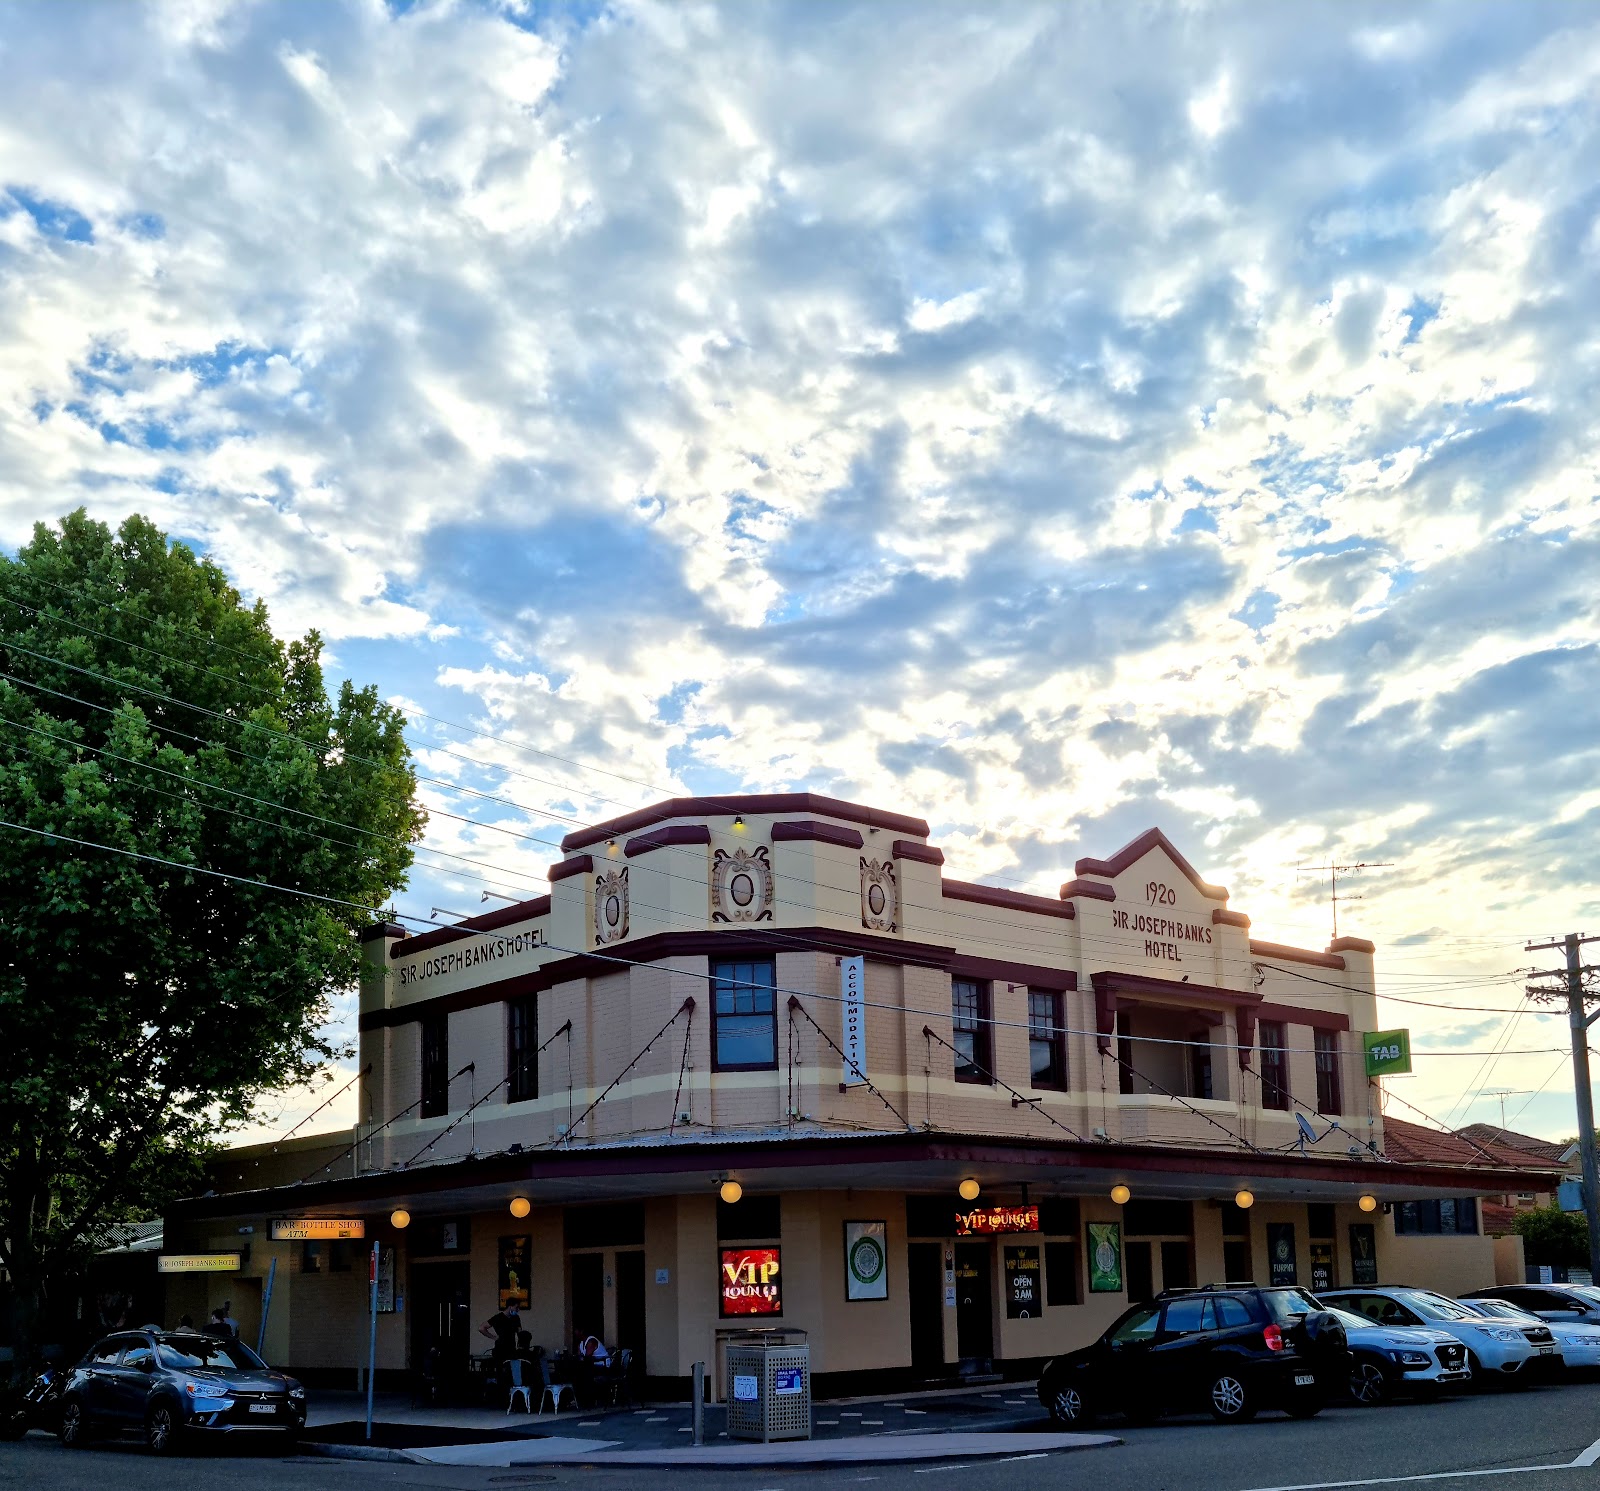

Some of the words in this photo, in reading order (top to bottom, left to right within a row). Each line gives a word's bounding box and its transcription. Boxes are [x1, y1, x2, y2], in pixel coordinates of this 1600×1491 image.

[1146, 882, 1176, 907] 1920
[1113, 909, 1128, 929] SIR
[1132, 914, 1175, 938] JOSEPH
[1177, 922, 1212, 944] BANKS
[401, 964, 417, 984] SIR
[420, 950, 463, 980] JOSEPH
[465, 940, 504, 969] BANKS
[506, 928, 548, 956] HOTEL
[1145, 940, 1181, 962] HOTEL
[1372, 1045, 1400, 1060] TAB
[275, 1221, 295, 1229] BAR
[300, 1221, 336, 1229] BOTTLE
[338, 1221, 362, 1229] SHOP
[962, 1211, 986, 1228] VIP
[286, 1230, 308, 1238] ATM
[723, 1256, 779, 1285] VIP
[1014, 1278, 1032, 1286] OPEN
